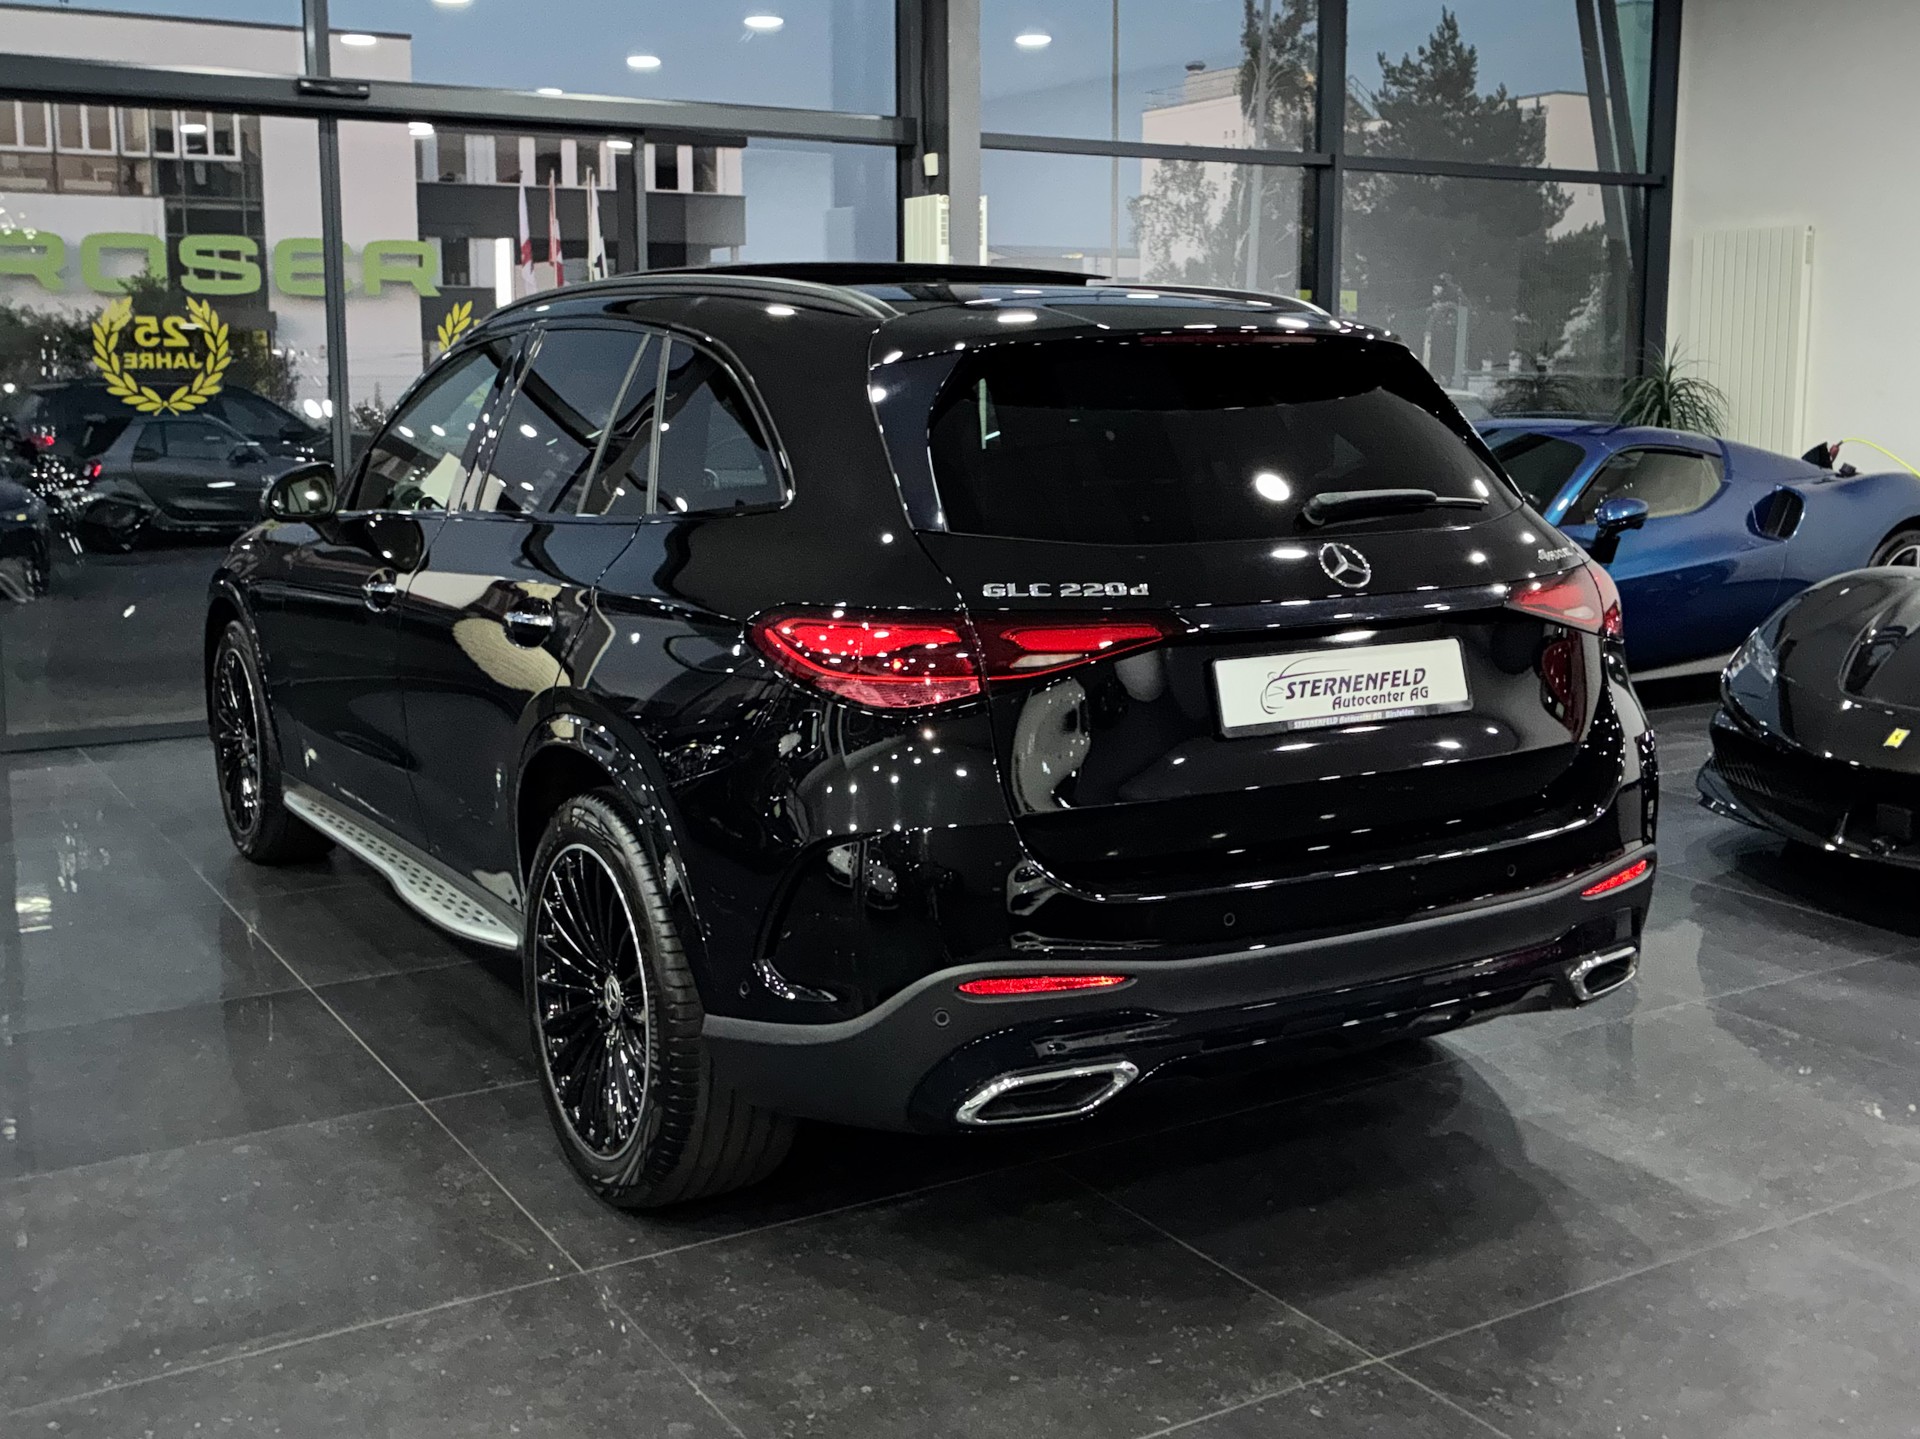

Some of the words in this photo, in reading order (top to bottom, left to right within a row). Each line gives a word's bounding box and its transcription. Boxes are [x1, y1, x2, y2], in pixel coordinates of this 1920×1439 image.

[982, 582, 1052, 597] GLC
[1059, 582, 1150, 597] 220d
[1285, 668, 1426, 700] STERNENFELD
[1332, 690, 1405, 710] Autocenter
[1410, 686, 1429, 701] AG
